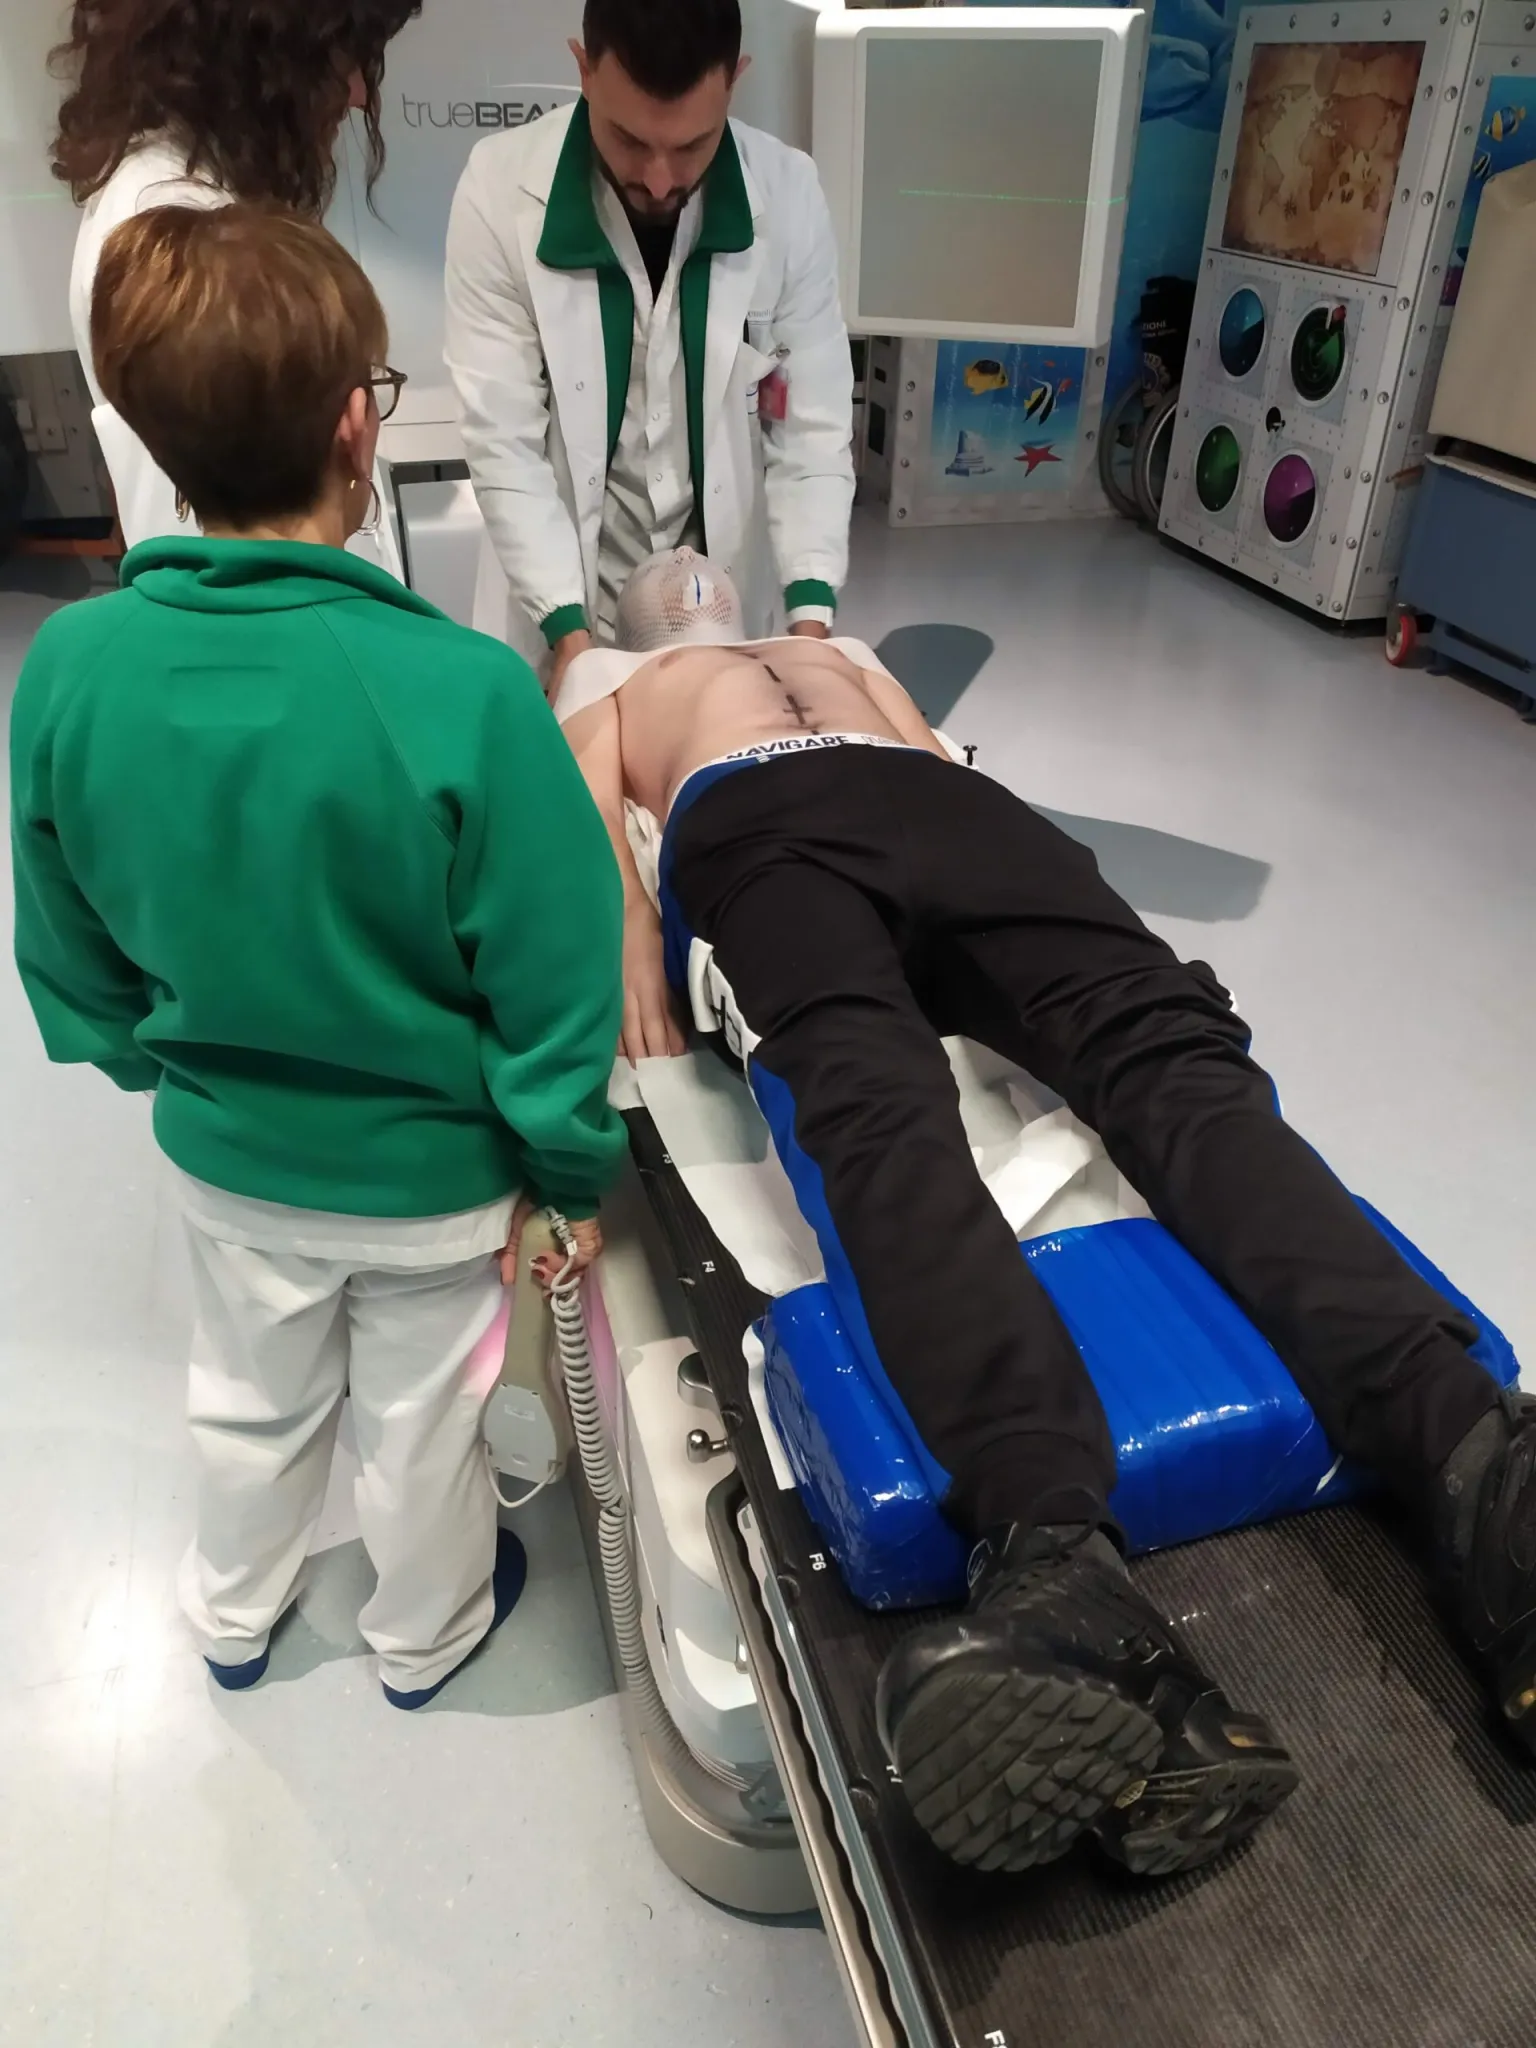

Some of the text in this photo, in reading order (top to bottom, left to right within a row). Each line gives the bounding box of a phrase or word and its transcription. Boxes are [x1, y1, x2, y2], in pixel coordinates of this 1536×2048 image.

[401, 93, 557, 128] trueBEA
[701, 1260, 716, 1273] F4
[809, 1552, 826, 1571] F6
[984, 2030, 1008, 2048] F
